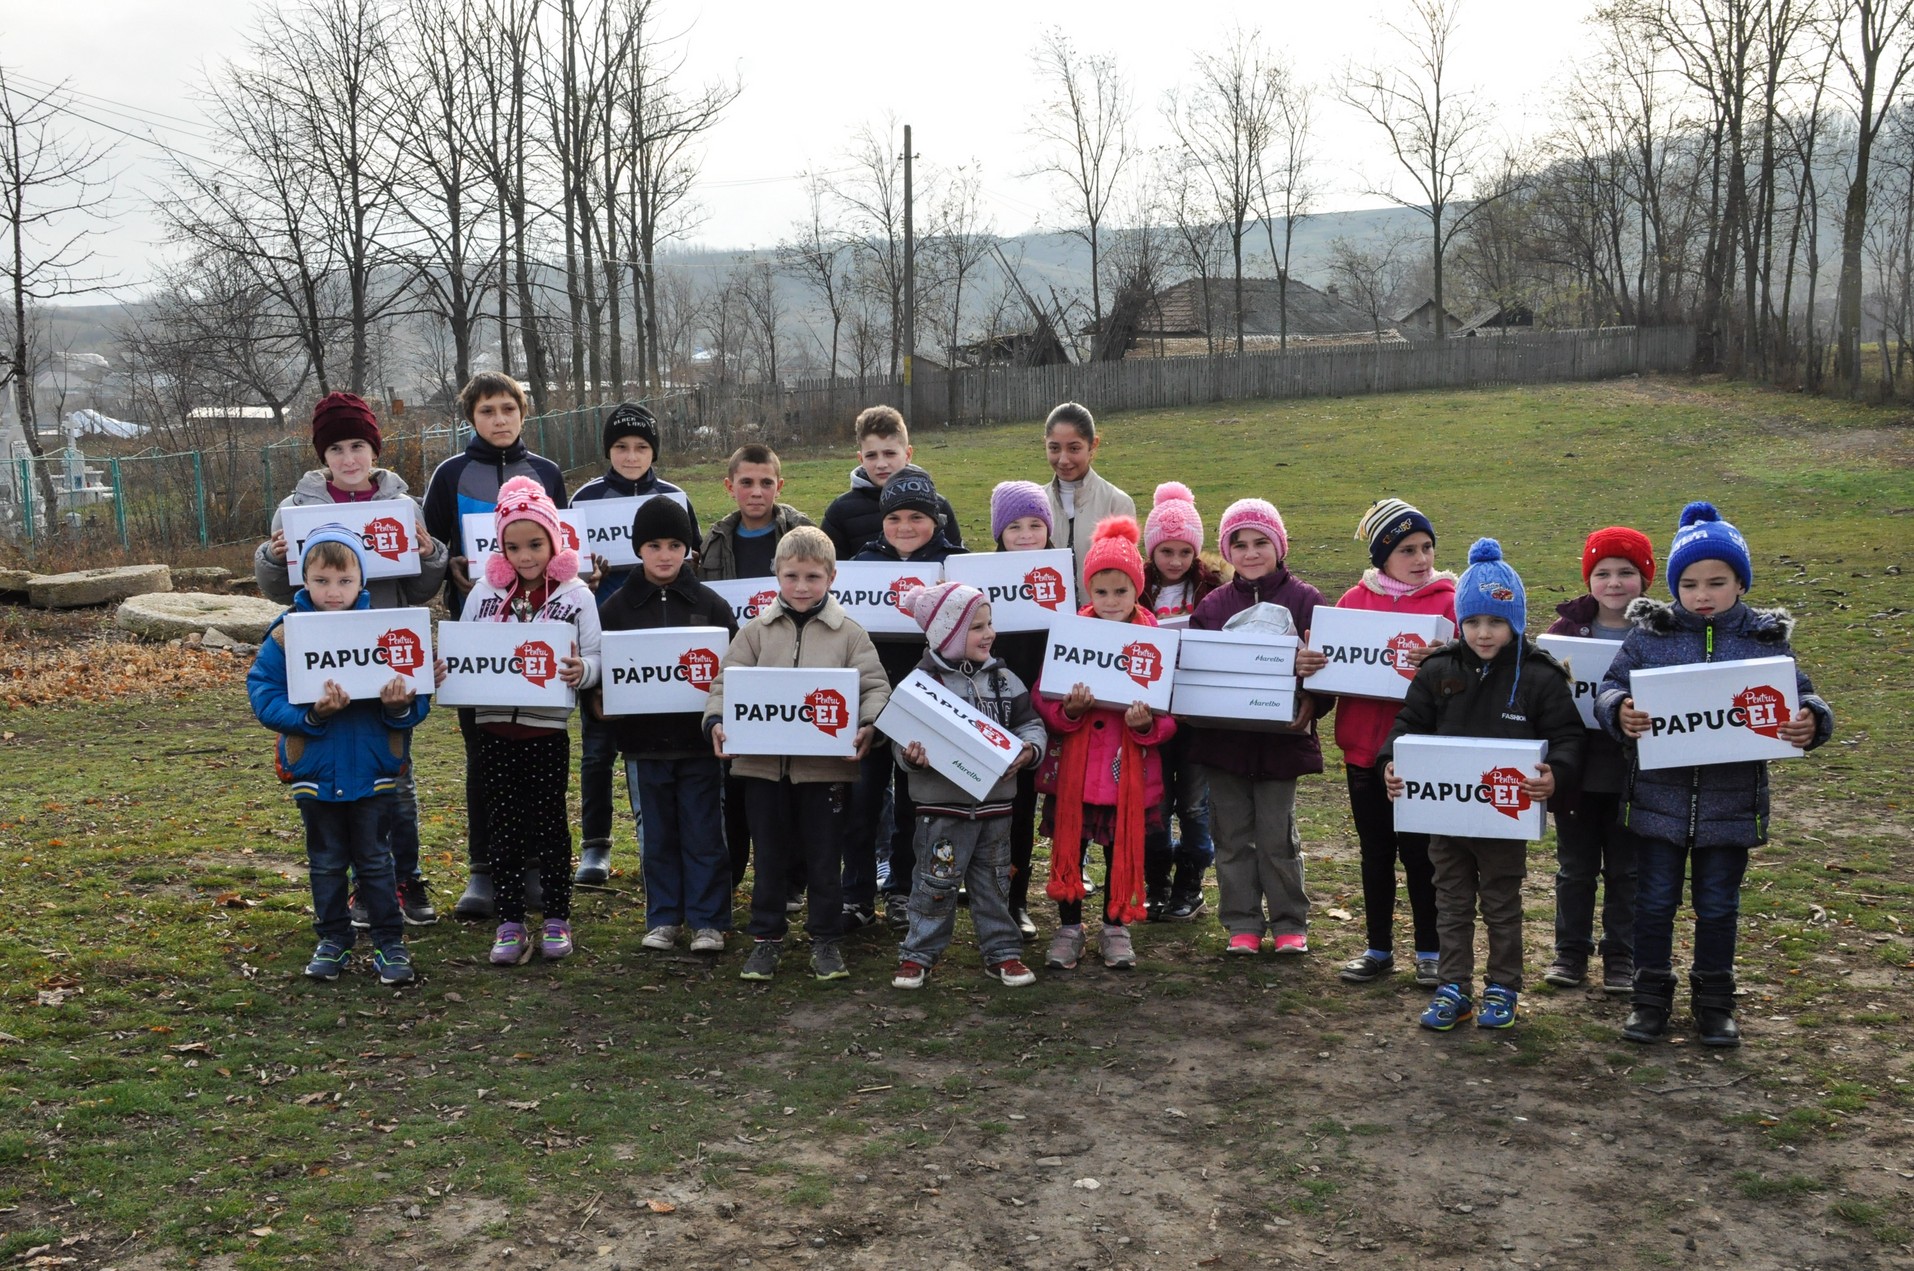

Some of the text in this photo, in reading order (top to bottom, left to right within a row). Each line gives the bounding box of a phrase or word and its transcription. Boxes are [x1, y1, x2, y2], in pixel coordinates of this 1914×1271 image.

[897, 481, 931, 493] YOU
[587, 525, 633, 543] PAPU
[387, 633, 414, 645] Pentru
[304, 645, 414, 670] PAPUCEI
[522, 645, 549, 656] Pentru
[687, 652, 713, 663] Pentru
[1130, 644, 1156, 659] Pentru
[1322, 645, 1416, 668] PAPUCE
[446, 656, 547, 675] PAPUCEI
[1053, 644, 1154, 676] PAPUCEI
[1255, 655, 1285, 663] Marelbo
[813, 693, 841, 705] Pentru
[1249, 699, 1281, 708] Marelbo
[1741, 691, 1777, 704] Pentru
[734, 703, 839, 722] PAPUCEI
[952, 760, 982, 782] Marelbo
[1490, 771, 1521, 784] Pentru
[1405, 781, 1520, 804] PAPUCEI
